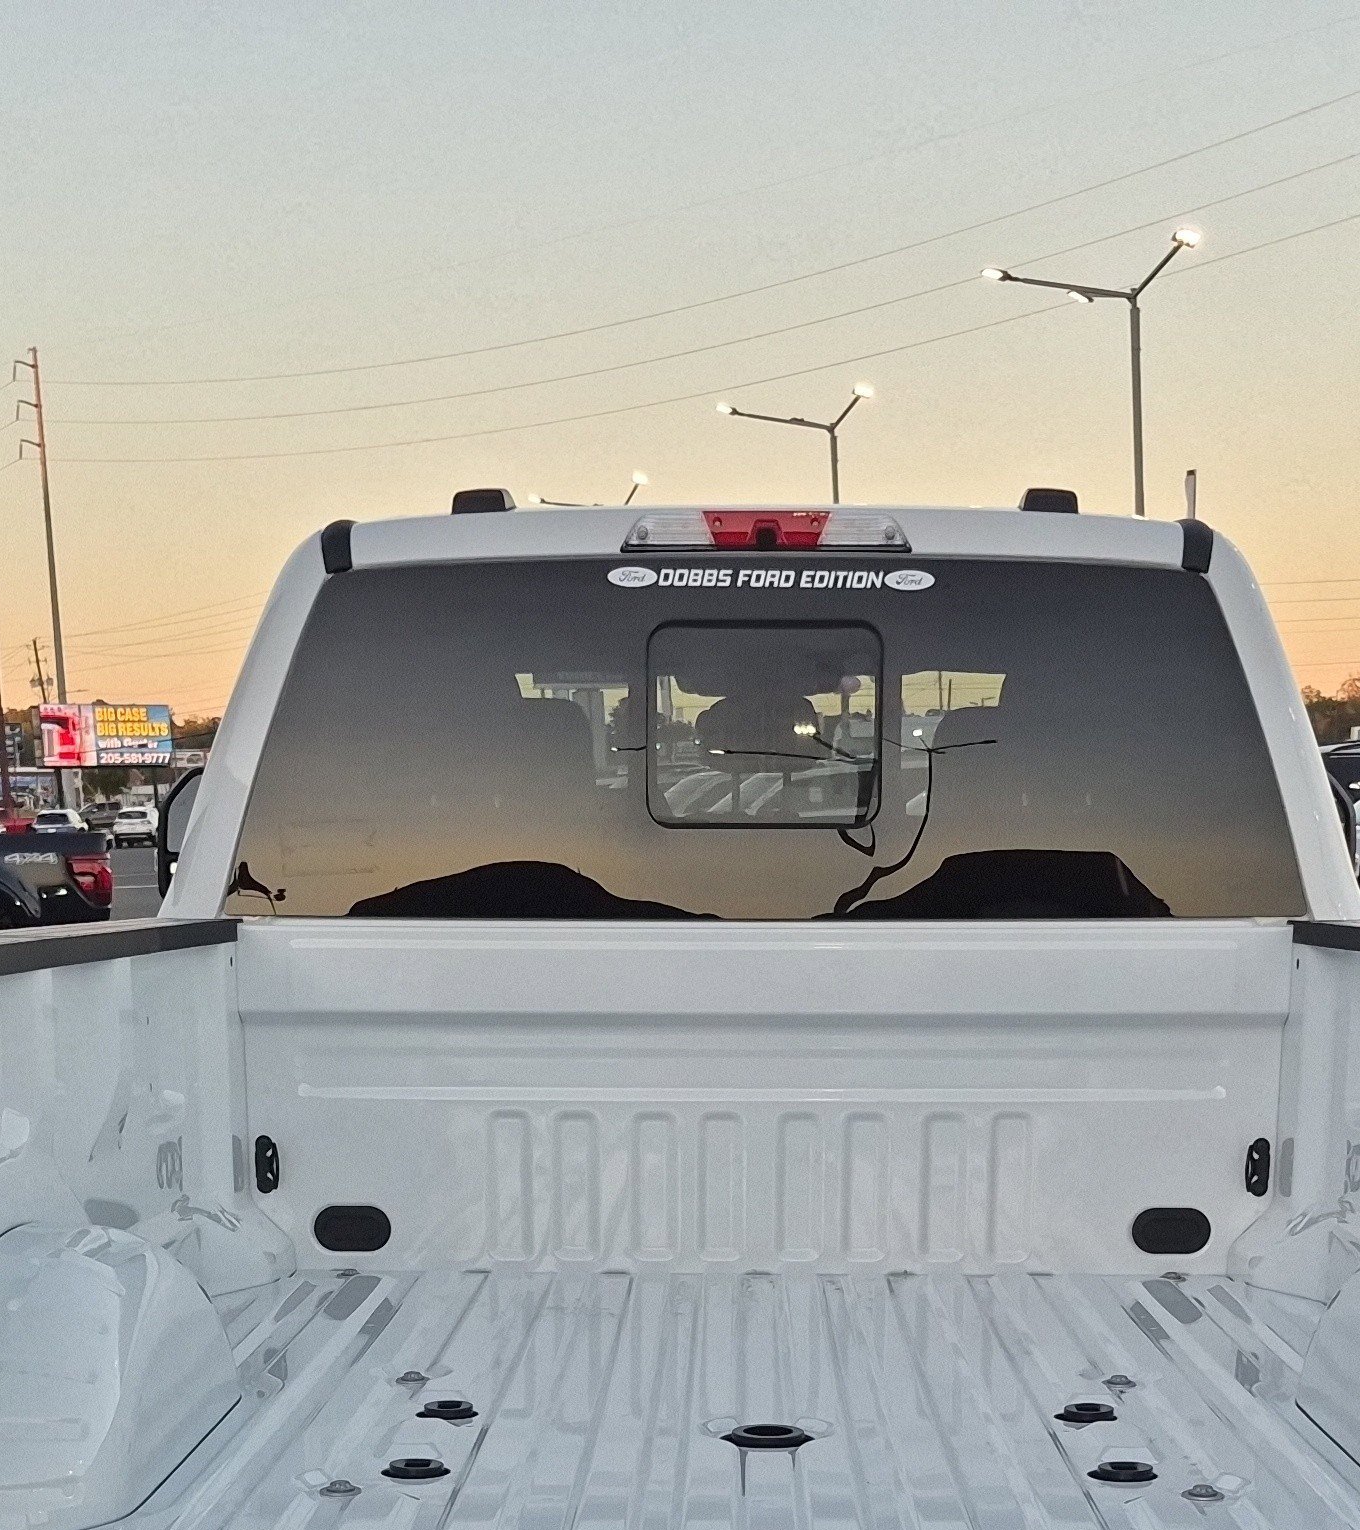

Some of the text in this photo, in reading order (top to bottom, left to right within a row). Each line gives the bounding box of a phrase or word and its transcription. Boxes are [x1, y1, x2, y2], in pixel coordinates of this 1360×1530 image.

[658, 568, 733, 587] DOBBS
[736, 569, 796, 588] FORD
[799, 570, 884, 589] EDITION
[95, 707, 148, 721] BIG CASE
[96, 722, 169, 736] BIG RESULTS
[100, 752, 170, 764] 205-581-9777
